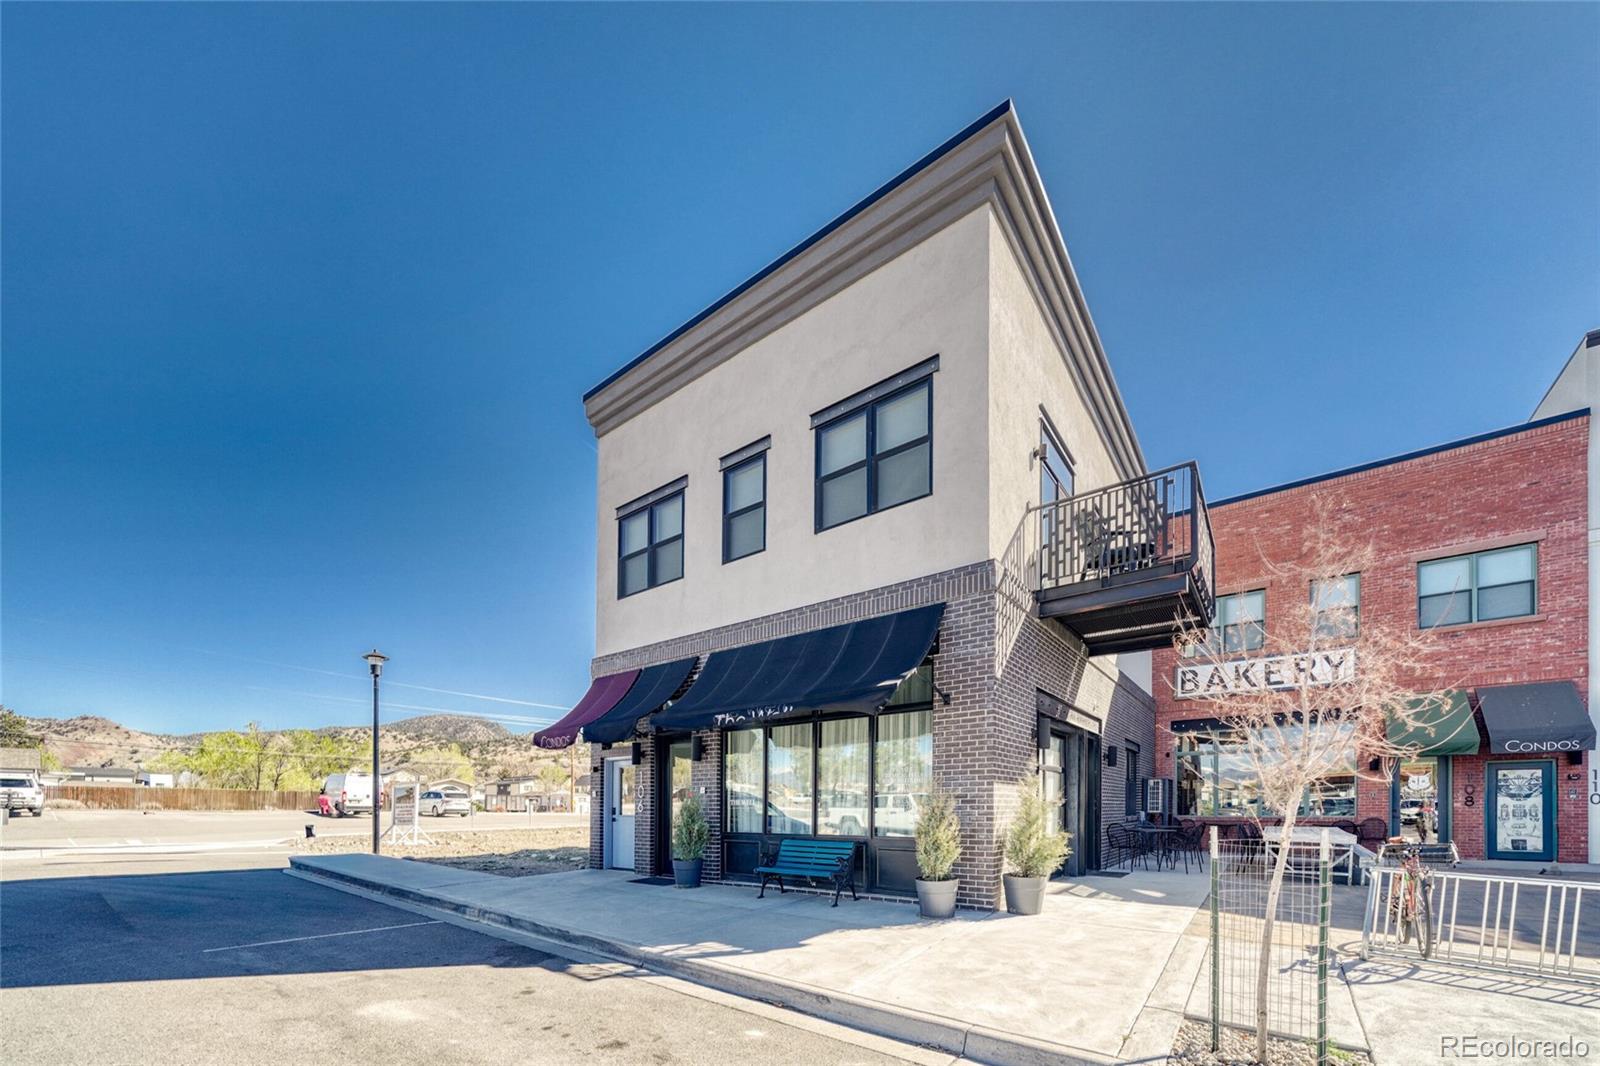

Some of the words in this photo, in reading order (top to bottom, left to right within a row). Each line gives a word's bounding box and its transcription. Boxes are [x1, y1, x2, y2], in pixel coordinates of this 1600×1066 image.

[1180, 653, 1345, 695] BAKERY
[1504, 739, 1580, 752] CONDOS
[1464, 772, 1476, 807] 108
[1590, 769, 1600, 805] 110
